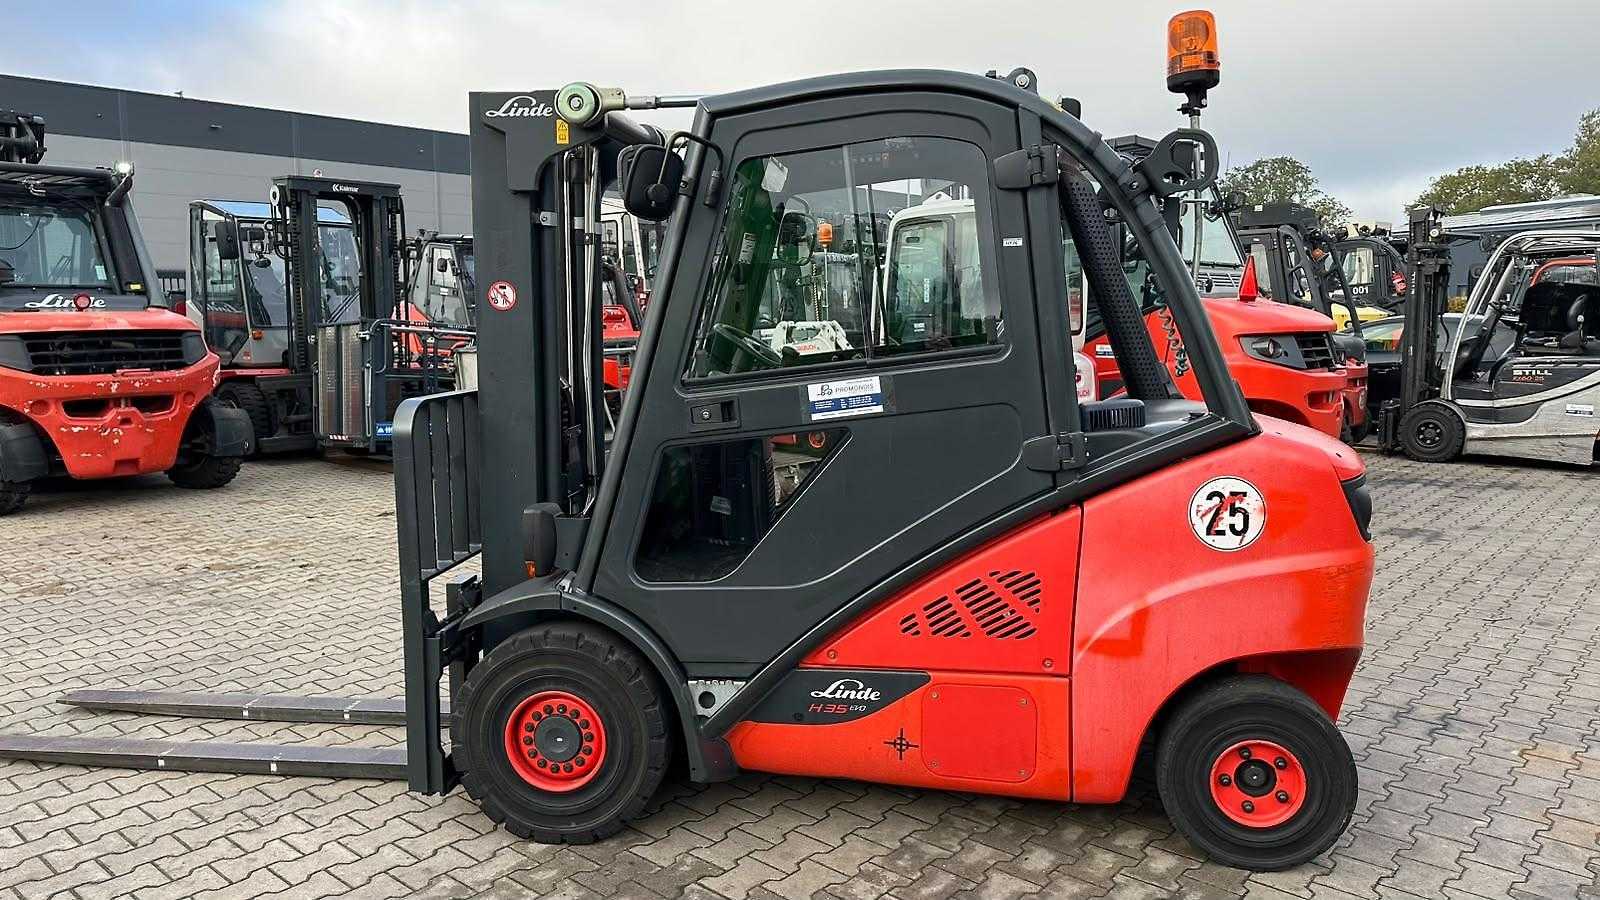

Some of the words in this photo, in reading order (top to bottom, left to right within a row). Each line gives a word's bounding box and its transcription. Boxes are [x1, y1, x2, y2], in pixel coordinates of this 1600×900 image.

[485, 95, 553, 117] Linde
[1352, 286, 1369, 295] 001
[1206, 490, 1250, 536] 25
[810, 678, 881, 701] Linde
[808, 703, 823, 713] H
[823, 703, 848, 714] 35
[849, 704, 867, 712] EVO
